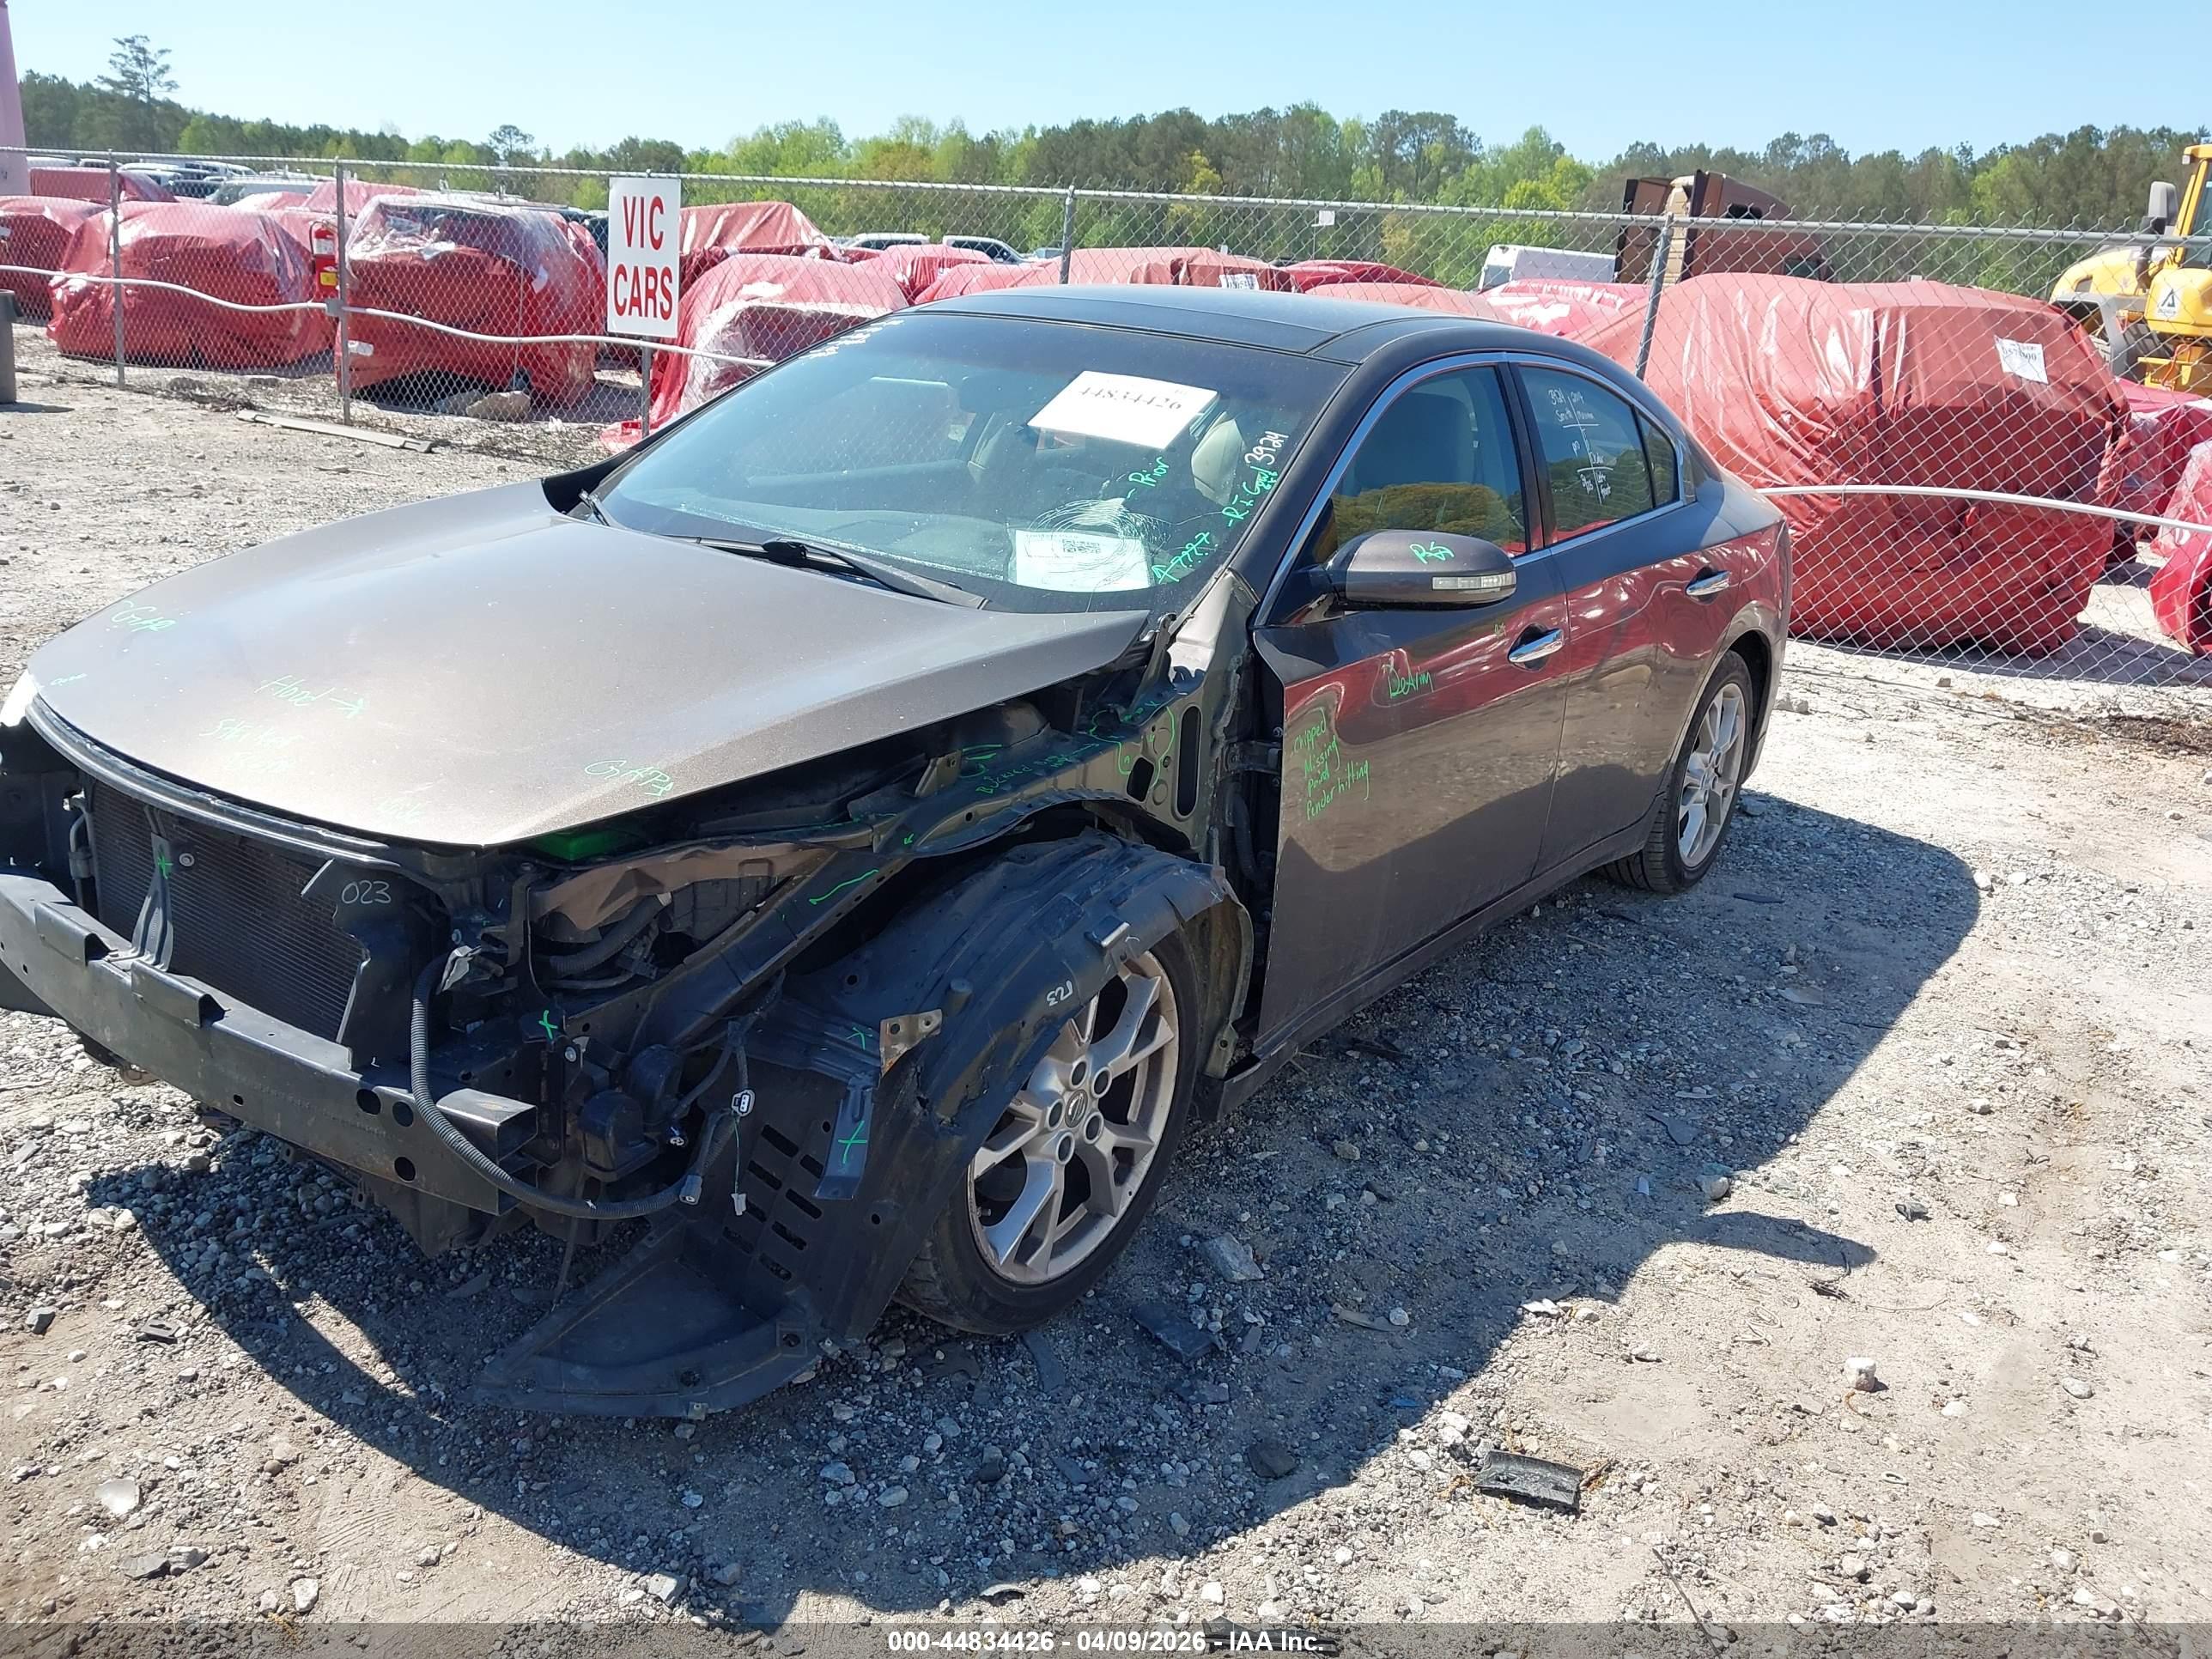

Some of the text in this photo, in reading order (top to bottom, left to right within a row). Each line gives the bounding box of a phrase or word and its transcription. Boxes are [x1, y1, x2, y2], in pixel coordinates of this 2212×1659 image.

[623, 196, 664, 250] VIC
[613, 264, 672, 320] CARS
[1245, 431, 1289, 465] 3924
[341, 880, 392, 904] 023
